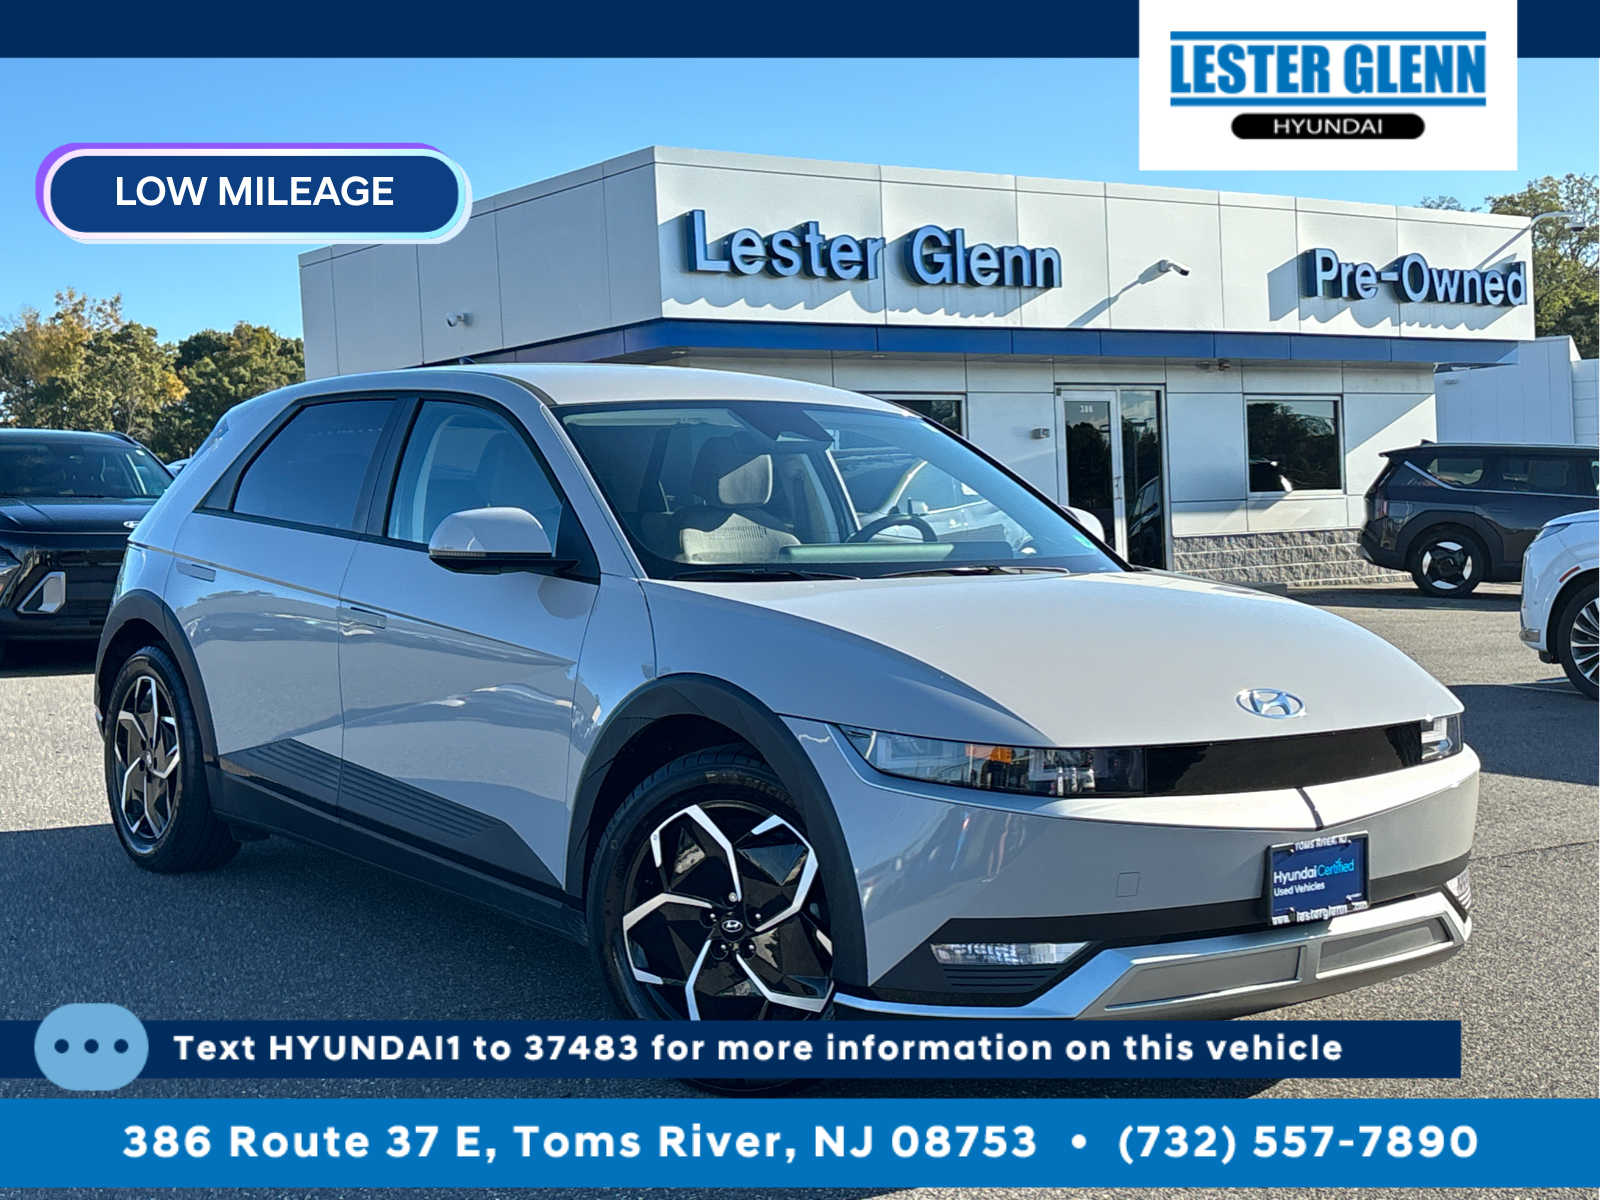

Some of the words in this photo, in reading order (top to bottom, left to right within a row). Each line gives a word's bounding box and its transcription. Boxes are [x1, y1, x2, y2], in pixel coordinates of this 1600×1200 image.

[688, 209, 886, 281] Lester
[908, 224, 1062, 289] Glenn
[1307, 248, 1528, 306] Pre-Owned
[1273, 886, 1294, 897] Used
[1294, 881, 1326, 895] Vehicles
